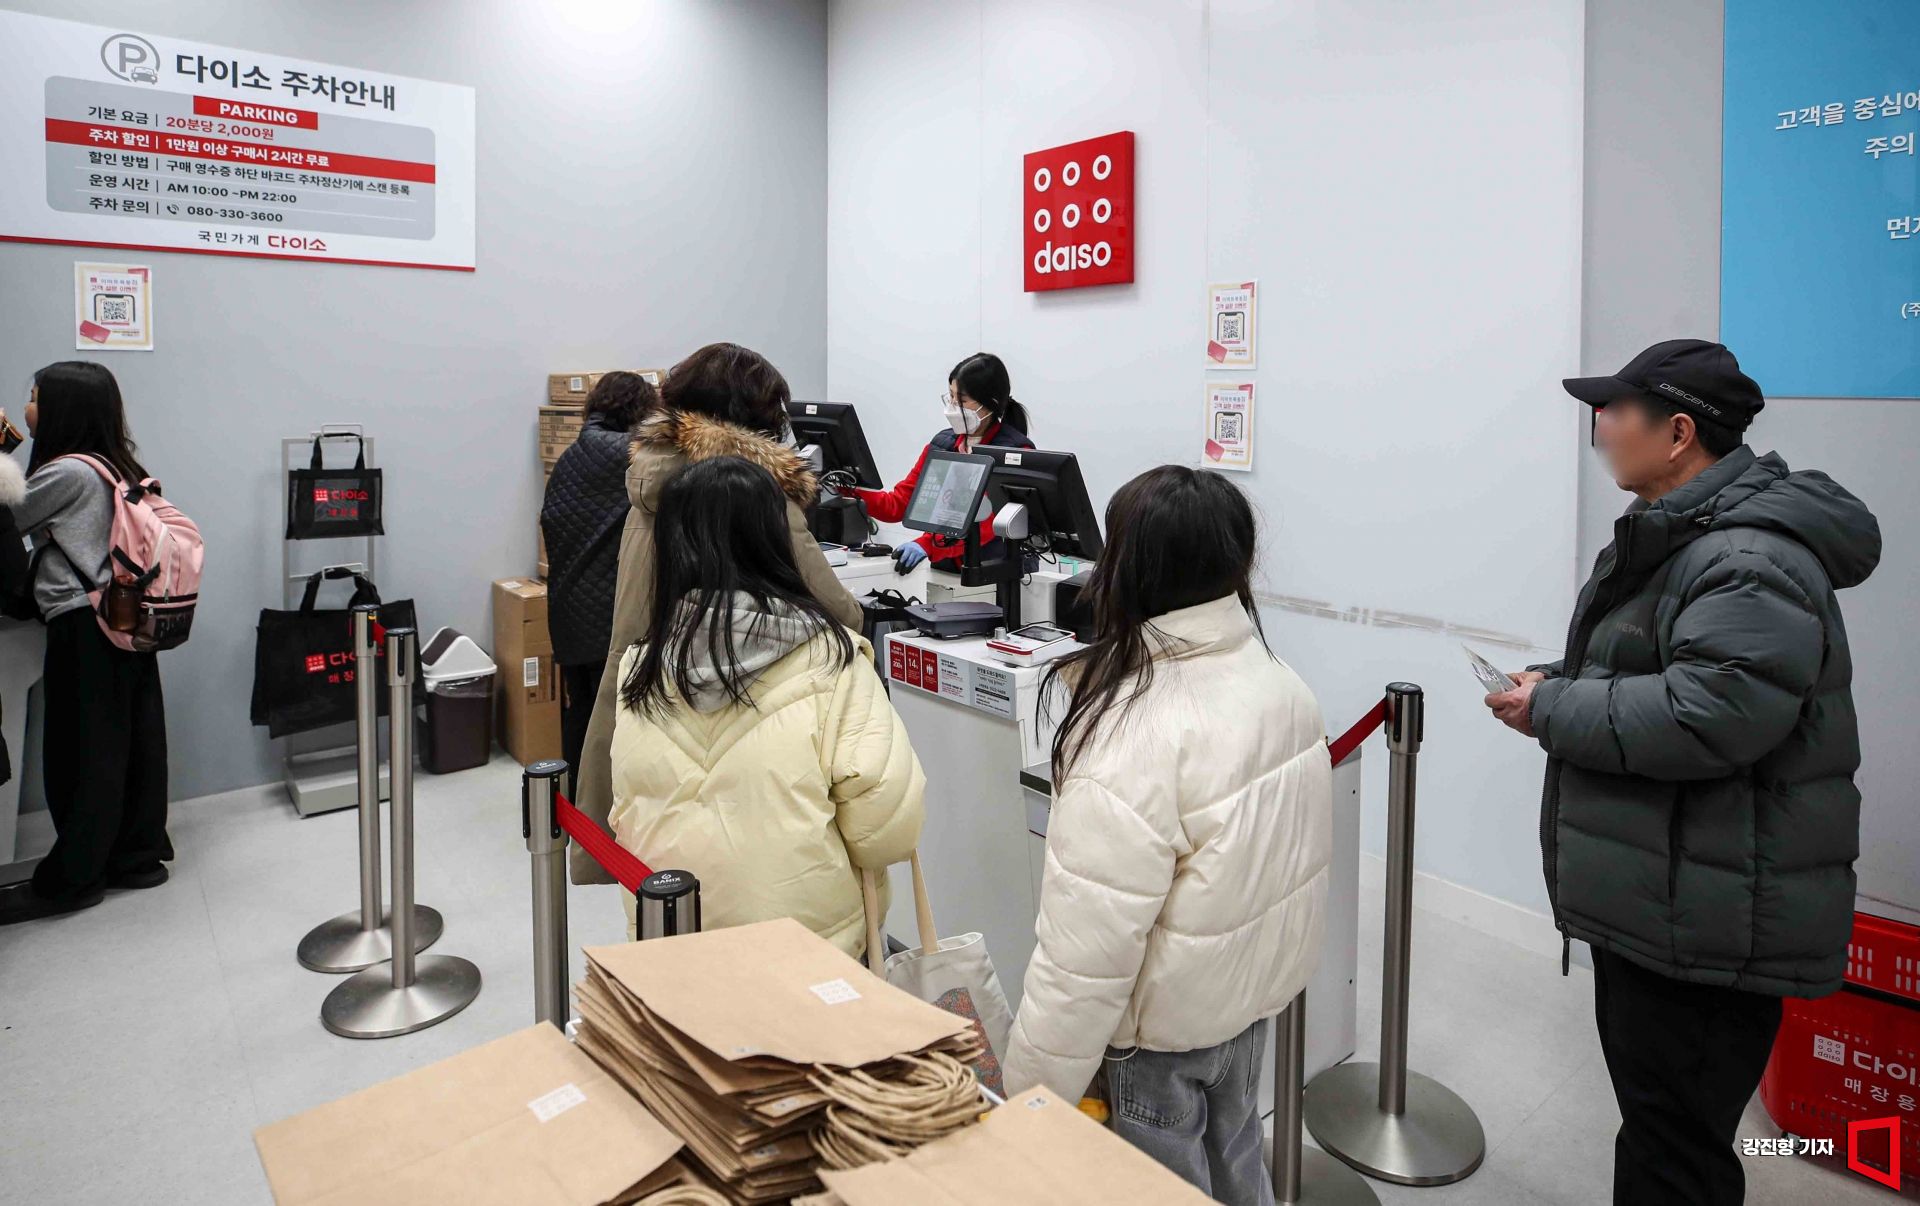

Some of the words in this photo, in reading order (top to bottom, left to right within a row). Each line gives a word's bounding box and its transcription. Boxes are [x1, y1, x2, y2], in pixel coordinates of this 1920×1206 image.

[176, 53, 273, 91] 다이소
[281, 69, 396, 112] 주차안내
[88, 106, 117, 121] 기본
[121, 110, 149, 125] 요금
[166, 116, 213, 133] 20분당
[217, 122, 274, 141] 2,000원
[219, 102, 299, 124] PARKING
[1775, 101, 1846, 131] 고객을
[89, 128, 119, 144] 주차
[122, 132, 150, 148] 할인
[166, 138, 200, 153] 1만원
[202, 143, 228, 156] 이상
[231, 146, 268, 160] 구매시
[271, 150, 304, 165] 2시간
[306, 154, 330, 167] 무료
[1863, 131, 1914, 160] 주의
[88, 151, 117, 166] 할인
[121, 155, 149, 169] 방법
[166, 160, 191, 173] 구매
[195, 163, 232, 177] 영수증
[234, 167, 258, 181] 하단
[261, 170, 295, 183] 바코드
[298, 174, 364, 191] 주차정산기에
[366, 182, 387, 194] 스캔
[390, 184, 410, 196] 등록
[89, 174, 118, 189] 운영
[122, 177, 150, 192] 시간
[167, 183, 189, 193] AM
[192, 186, 229, 197] 10:00
[262, 192, 297, 203] 22:00
[89, 197, 118, 212] 주차
[122, 200, 150, 214] 문의
[187, 206, 283, 223] 080-330-3600
[267, 235, 327, 252] 다이소
[1034, 240, 1112, 274] daiso
[1659, 383, 1721, 416] DESCENTE
[1853, 1050, 1920, 1086] 다이
